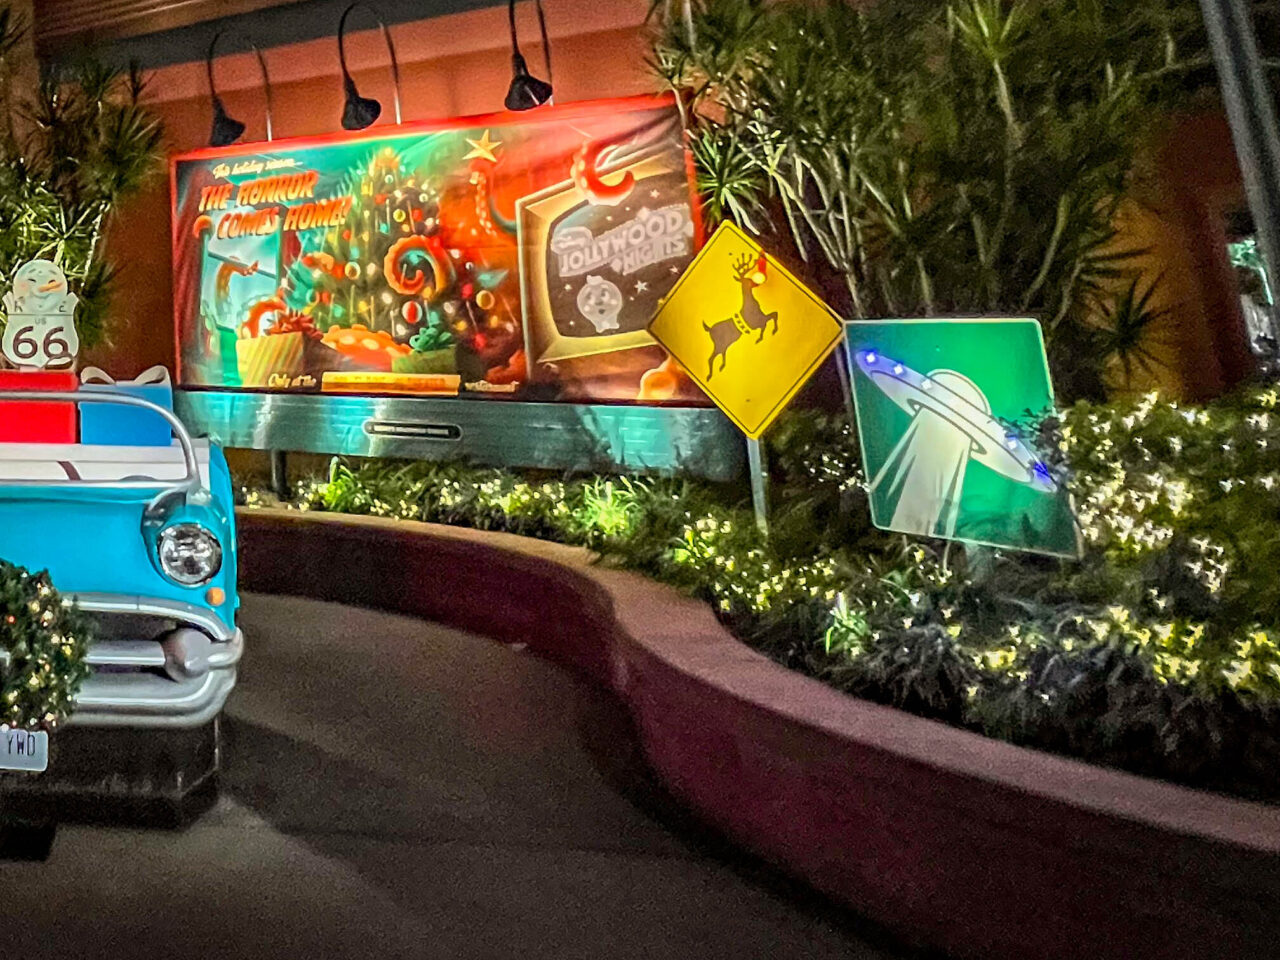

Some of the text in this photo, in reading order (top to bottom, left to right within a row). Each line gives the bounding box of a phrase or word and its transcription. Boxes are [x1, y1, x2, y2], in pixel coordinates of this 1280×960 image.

[199, 170, 318, 212] THE HORROR
[218, 196, 353, 238] COMES HOME!
[561, 210, 684, 274] JOLLYWOOD
[12, 325, 69, 359] 66
